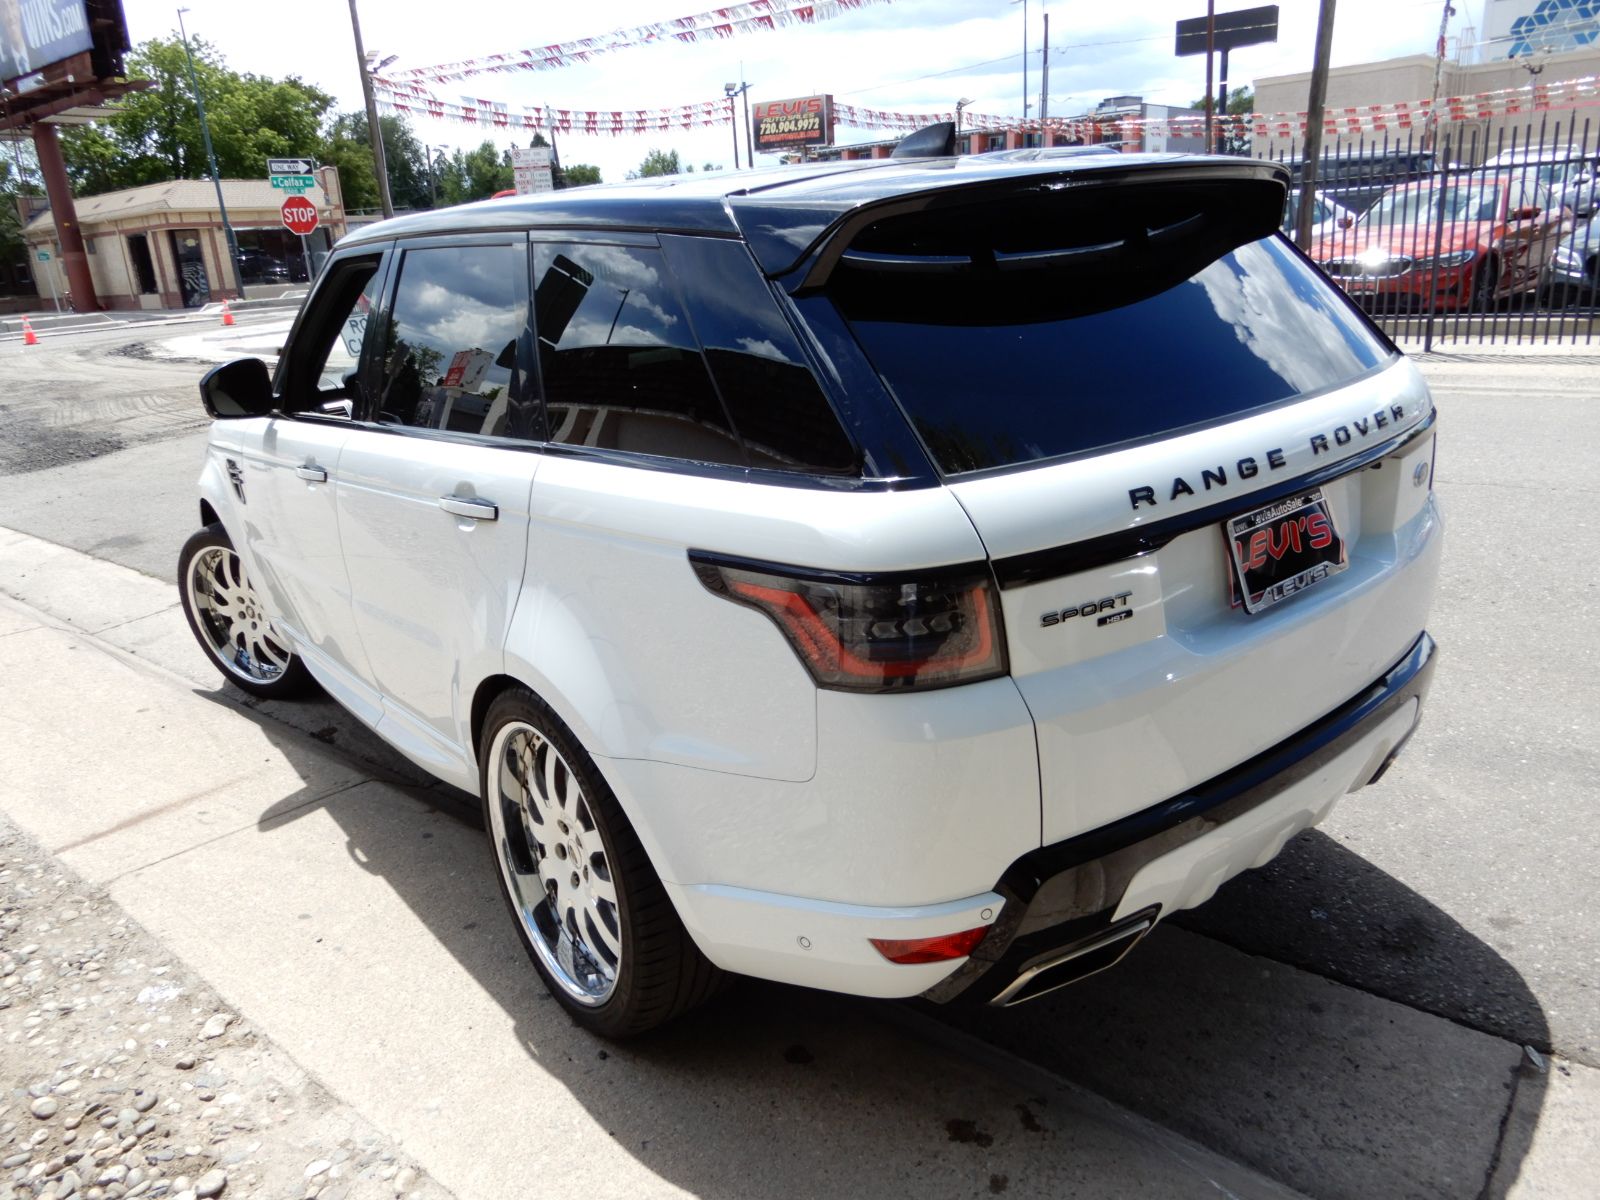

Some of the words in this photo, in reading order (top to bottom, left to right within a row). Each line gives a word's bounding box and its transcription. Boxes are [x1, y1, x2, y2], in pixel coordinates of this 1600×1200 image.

[755, 99, 822, 119] LEVI'S
[762, 115, 787, 123] AUTO
[787, 112, 815, 121] SALES
[760, 117, 820, 135] 720.904.9972
[273, 163, 286, 171] ONE
[277, 177, 304, 187] Colfax
[284, 207, 315, 223] STOP
[1128, 448, 1287, 510] RANGE
[1310, 402, 1405, 455] ROVER
[1235, 512, 1333, 574] LEVI'S
[1272, 565, 1328, 601] LEVI'S
[1040, 590, 1133, 628] SPORT
